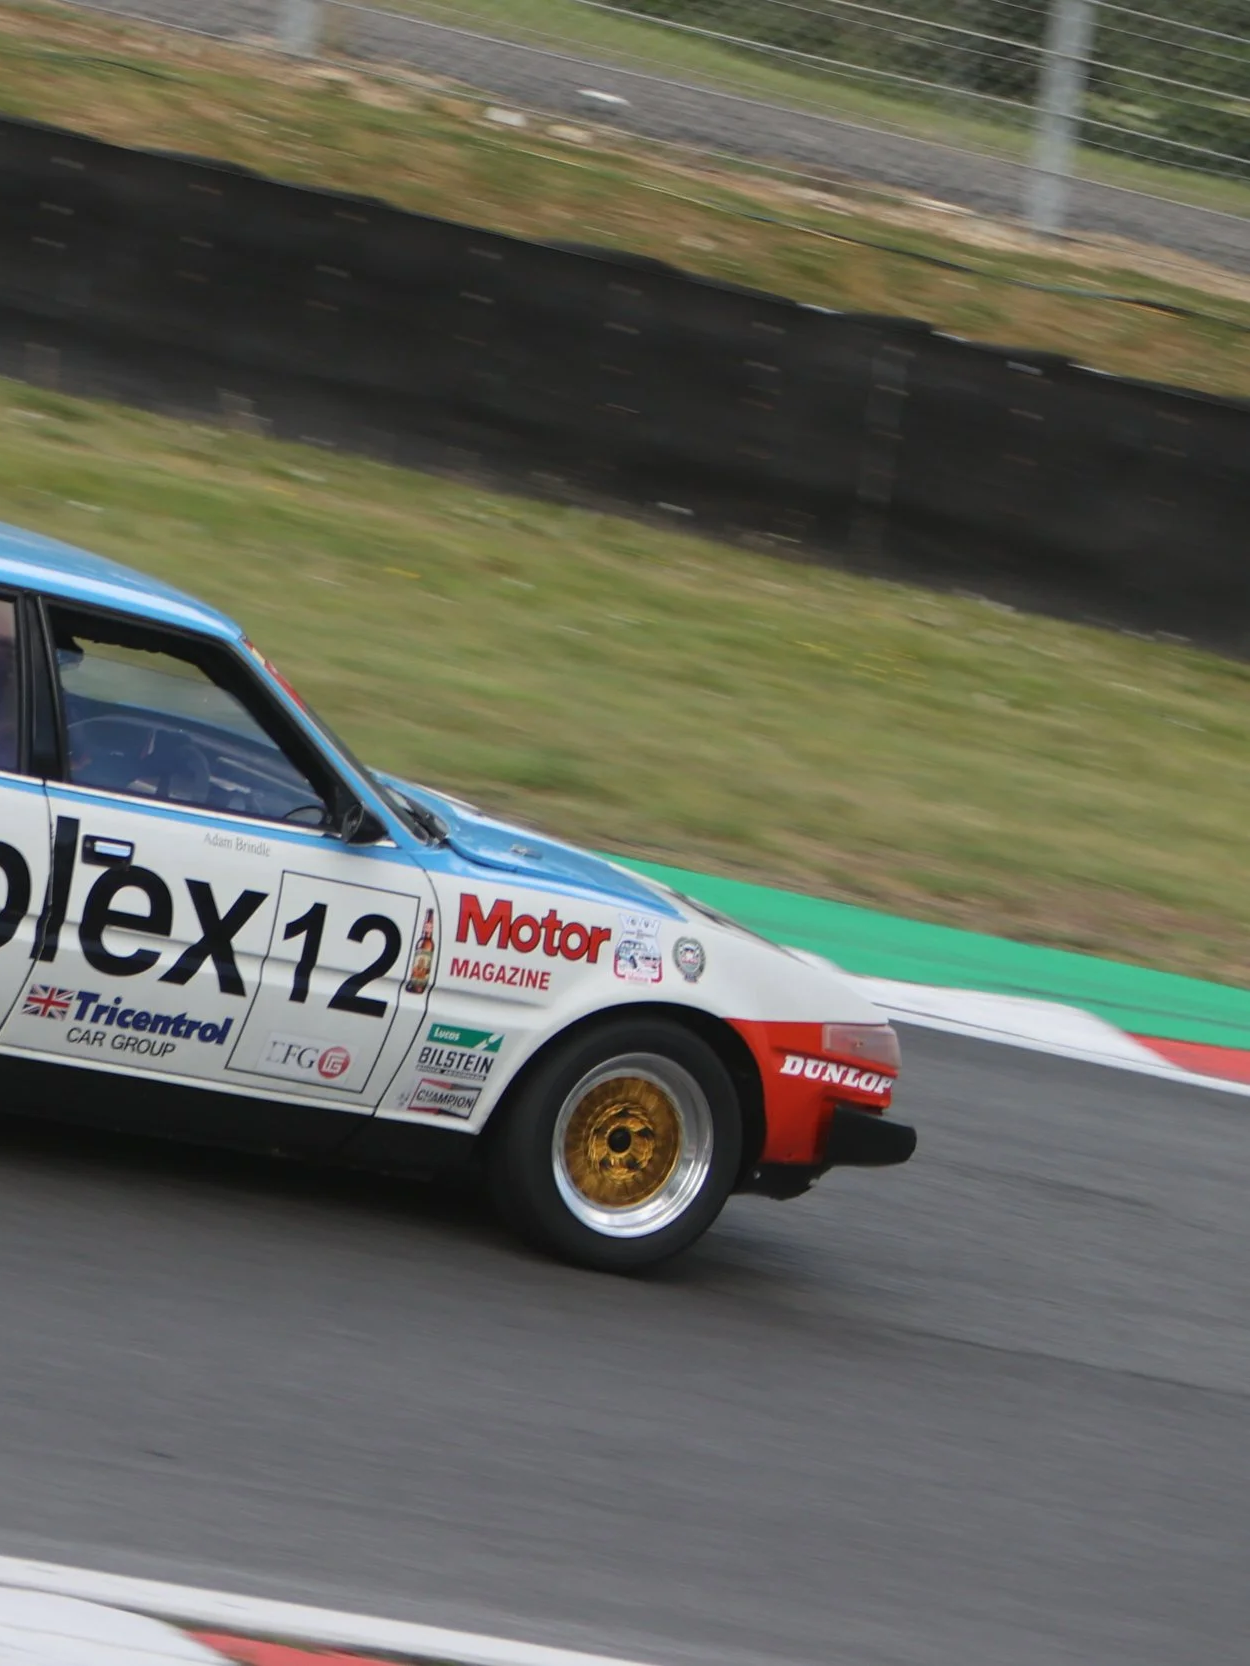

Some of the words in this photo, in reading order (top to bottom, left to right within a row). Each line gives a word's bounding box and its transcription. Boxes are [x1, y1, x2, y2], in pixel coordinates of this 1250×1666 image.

[204, 832, 233, 849] Adam
[235, 836, 271, 857] Brindle
[455, 892, 612, 964] Motor
[283, 902, 402, 1018] 12
[450, 957, 552, 992] MAGAZINE
[74, 990, 235, 1046] Tricentrol
[66, 1026, 106, 1048] CAR
[110, 1033, 177, 1058] GROUP
[417, 1046, 495, 1075] BILSTEIN
[780, 1054, 893, 1095] DUNLOP
[415, 1088, 475, 1110] CHAMPION
